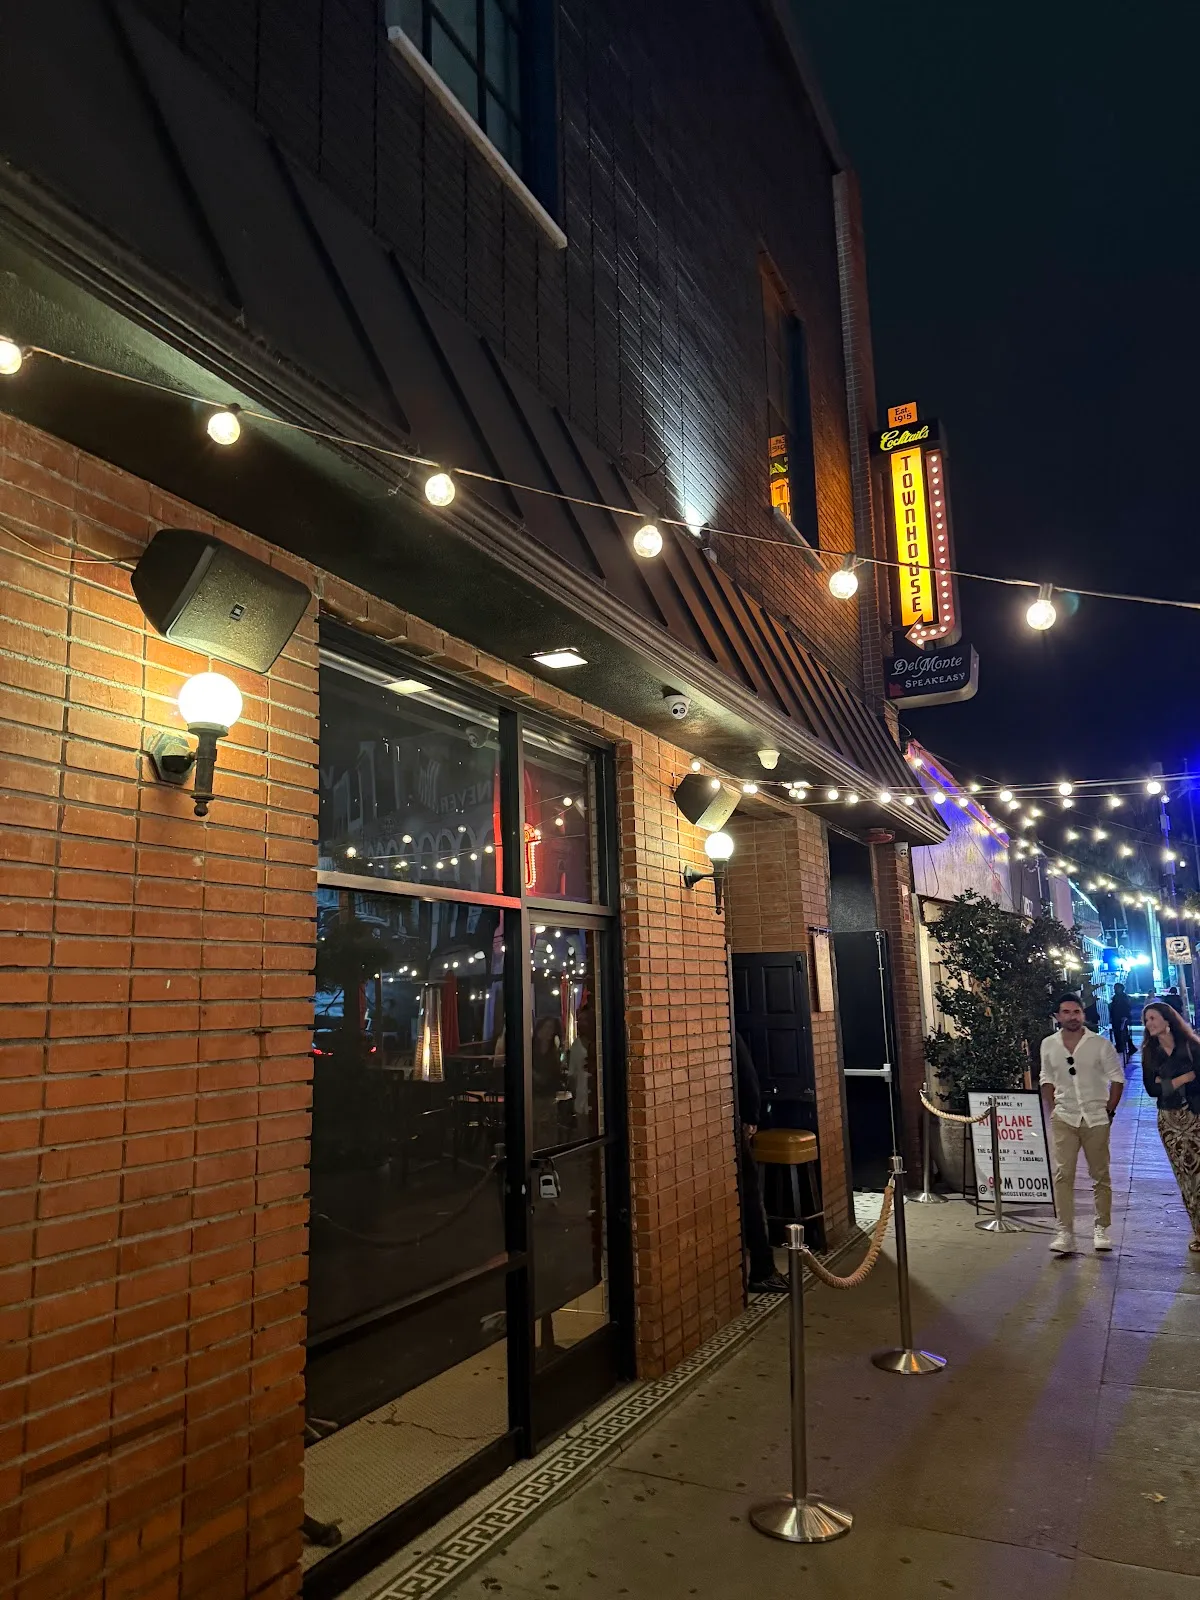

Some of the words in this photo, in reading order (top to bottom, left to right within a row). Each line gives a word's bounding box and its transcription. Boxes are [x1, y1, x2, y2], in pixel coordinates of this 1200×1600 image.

[894, 407, 910, 416] Est.
[894, 413, 912, 423] 1915
[880, 425, 930, 451] Cocktails
[900, 455, 922, 613] TOWNHOUSE
[905, 672, 966, 688] SPEAKEASY
[979, 1115, 1033, 1127] AIPLANE
[1018, 1177, 1049, 1190] DOOR
